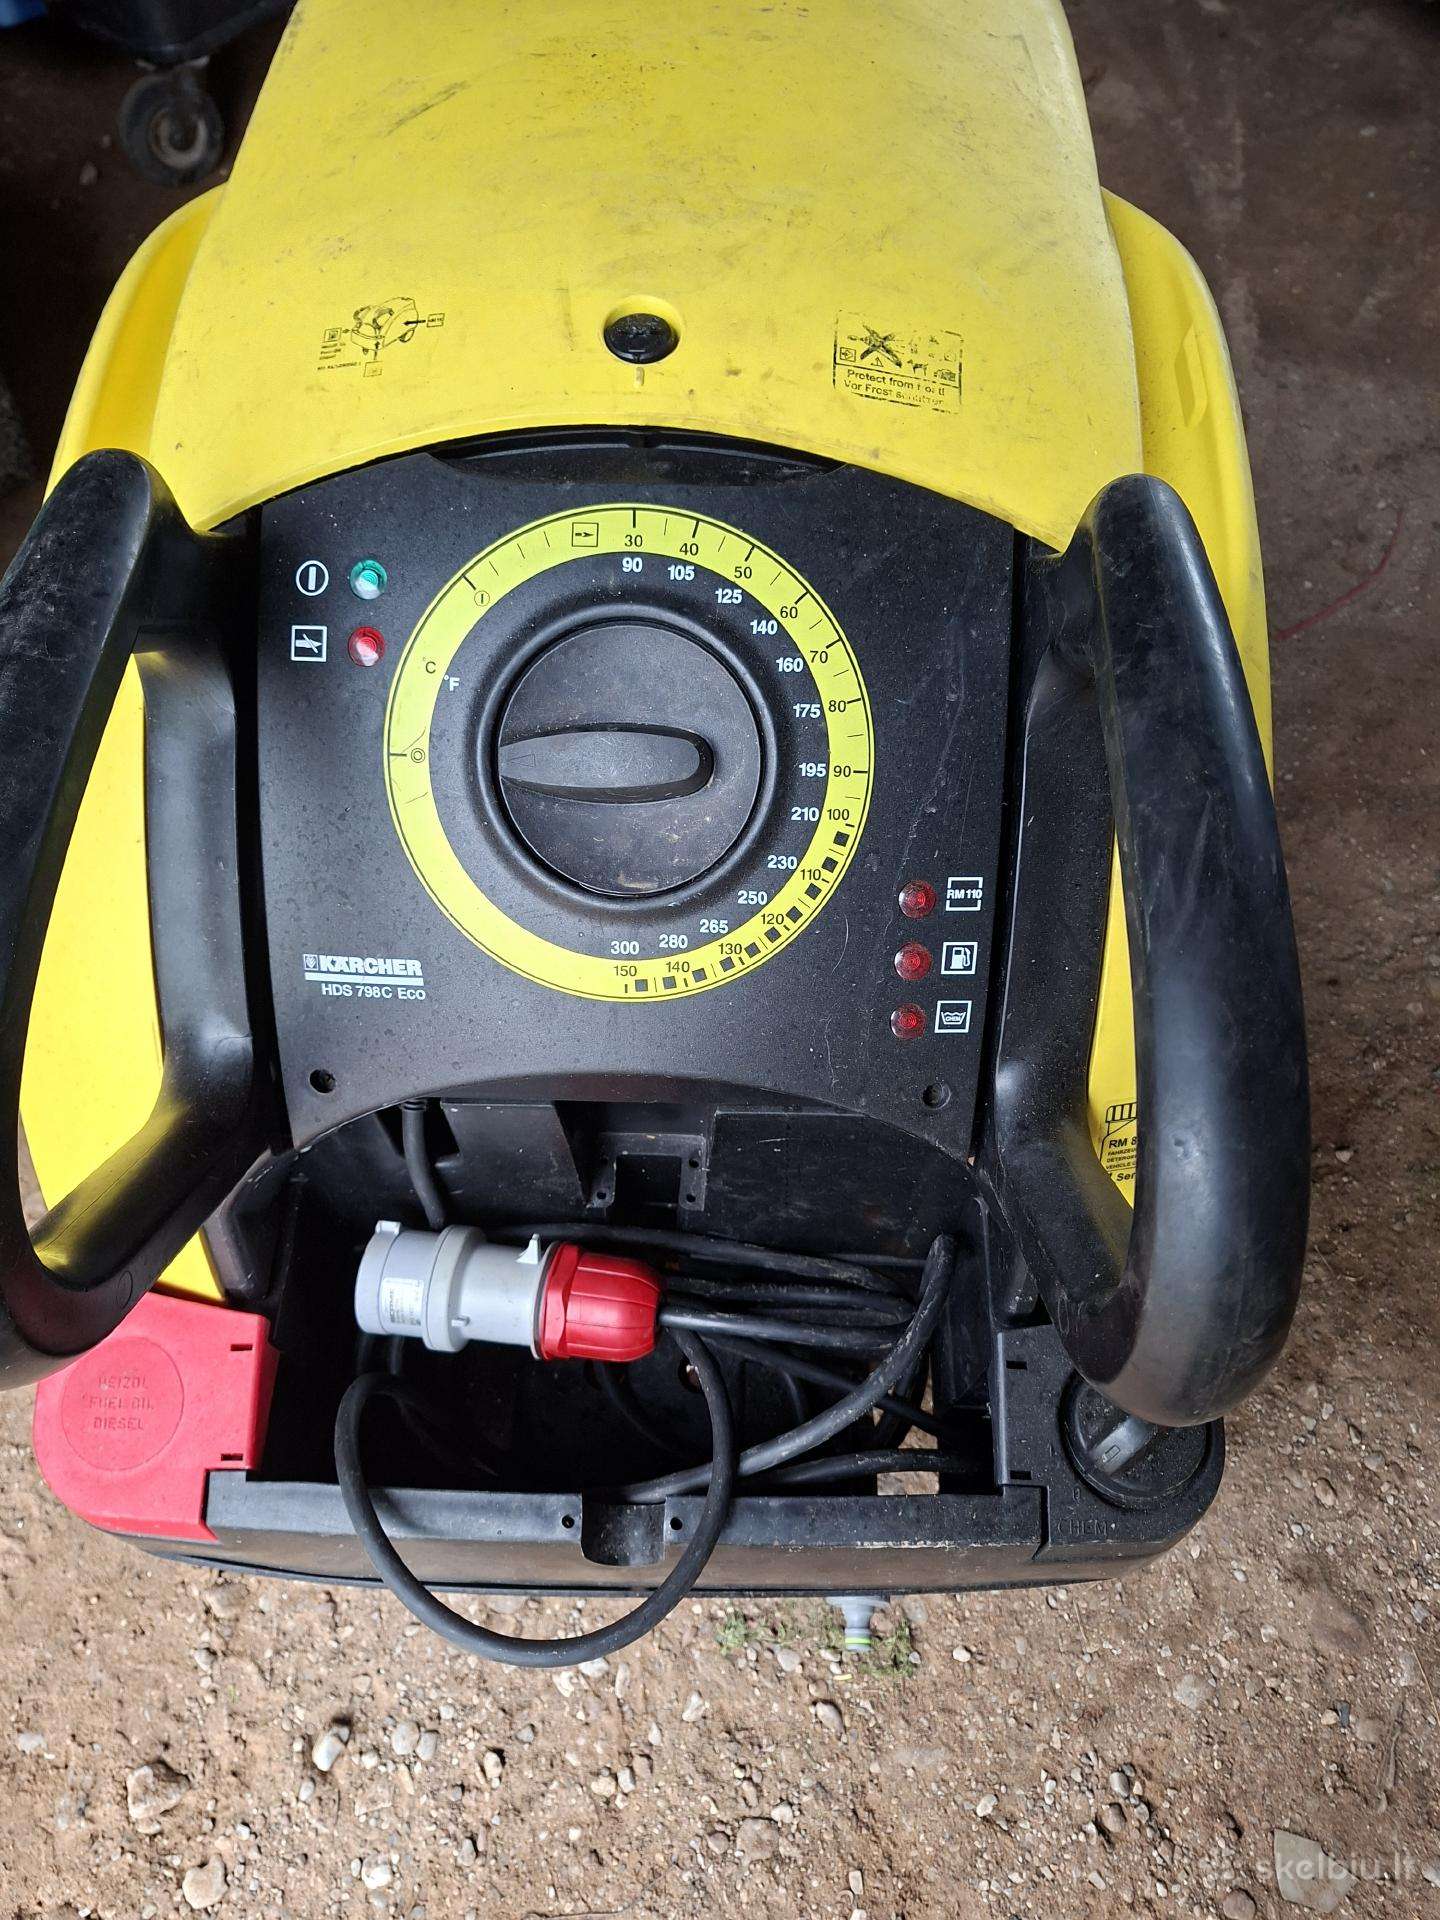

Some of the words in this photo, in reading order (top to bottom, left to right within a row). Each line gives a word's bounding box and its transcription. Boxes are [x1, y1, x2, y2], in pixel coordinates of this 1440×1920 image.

[847, 369, 887, 384] Protect
[889, 377, 914, 390] from
[624, 534, 643, 548] 30
[679, 543, 699, 556] 40
[622, 557, 643, 573] 90
[667, 565, 695, 581] 105
[734, 566, 752, 579] 50
[715, 588, 743, 604] 125
[780, 606, 798, 619] 60
[750, 619, 778, 635] 140
[810, 650, 828, 664] 70
[776, 657, 804, 673] 160
[793, 703, 821, 718] 175
[828, 699, 847, 712] 80
[799, 762, 827, 777] 195
[833, 765, 852, 778] 90
[790, 806, 820, 821] 210
[827, 808, 850, 821] 100
[767, 854, 798, 870] 230
[800, 869, 821, 881] 110
[737, 890, 768, 905] 250
[947, 889, 964, 899] RM
[966, 889, 983, 899] 110
[699, 919, 729, 934] 265
[761, 914, 784, 925] 120
[610, 940, 640, 955] 300
[659, 933, 689, 949] 280
[719, 943, 743, 955] 130
[614, 965, 637, 977] 150
[666, 961, 690, 973] 140
[321, 983, 353, 996] HDS
[1109, 1138, 1128, 1149] RM
[1106, 1154, 1137, 1163] DETERGE
[1107, 1147, 1137, 1156] FAHRZEU
[1116, 1172, 1136, 1182] Ser
[89, 1395, 126, 1410] FUEL
[132, 1396, 155, 1410] OIL
[93, 1416, 144, 1431] DIESEL
[1057, 1519, 1108, 1537] CHEM
